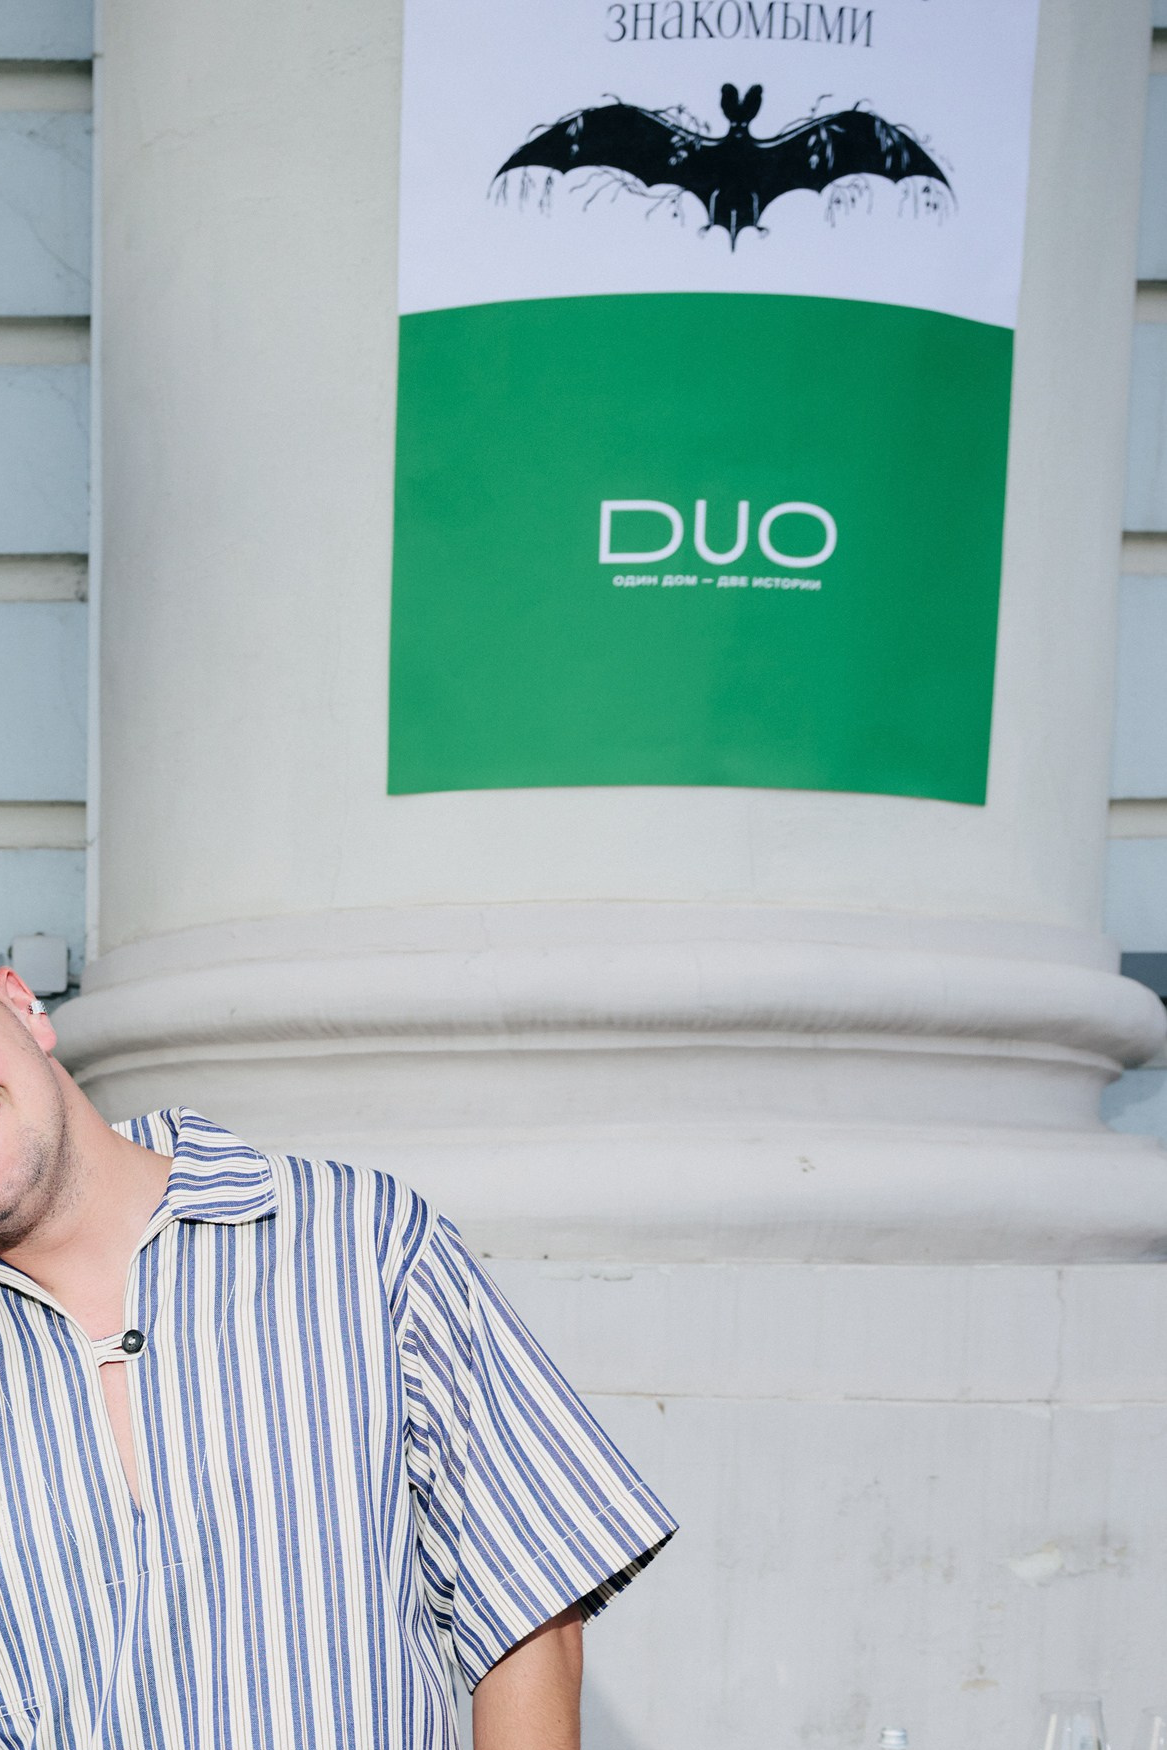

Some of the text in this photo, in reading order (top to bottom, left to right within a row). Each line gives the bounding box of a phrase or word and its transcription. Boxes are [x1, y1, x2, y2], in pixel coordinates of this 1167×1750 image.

[598, 499, 838, 569] DUO
[612, 574, 658, 588] ОДИН
[661, 574, 698, 588] ДОМ
[716, 575, 749, 589] ДВЕ
[751, 576, 822, 591] ИСТОРИИ
